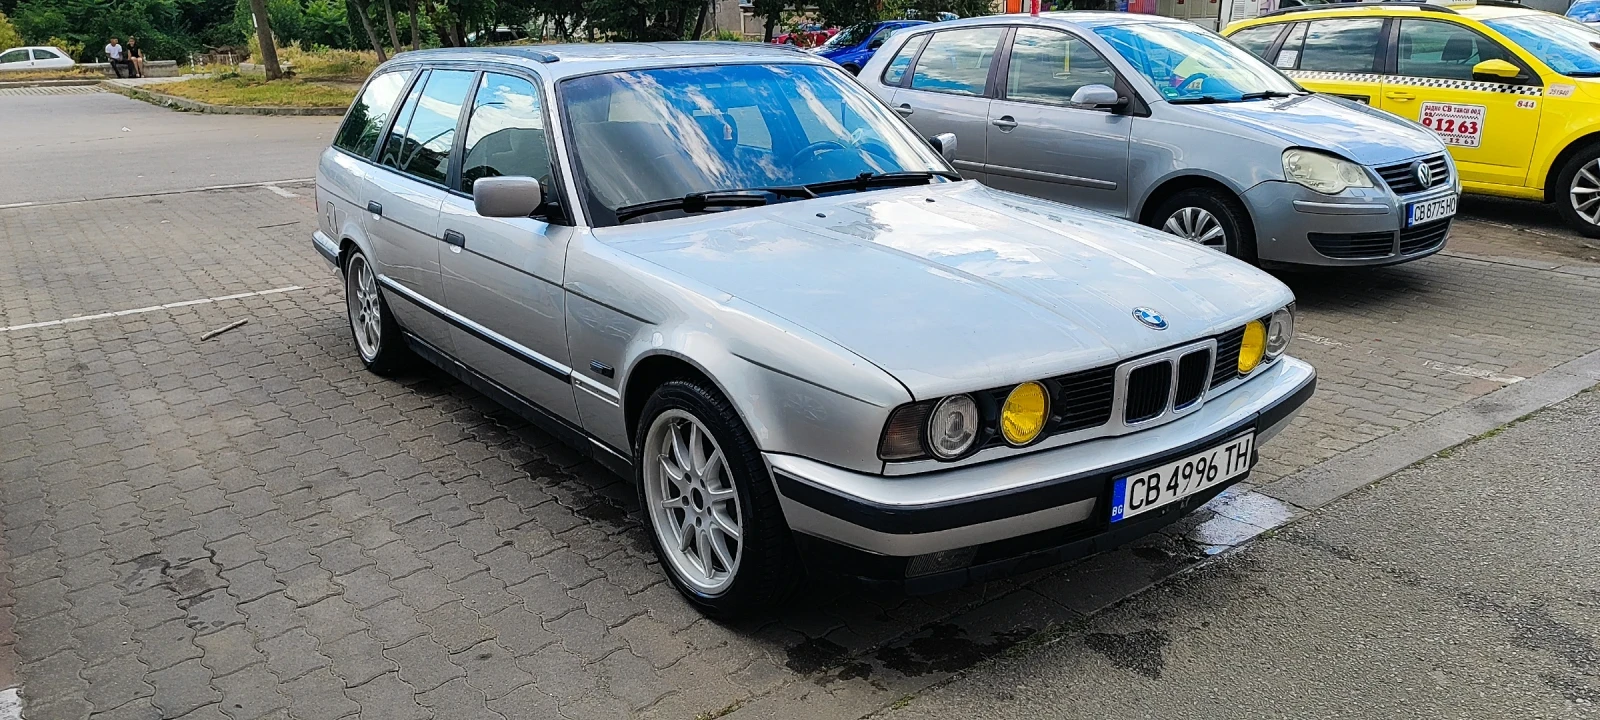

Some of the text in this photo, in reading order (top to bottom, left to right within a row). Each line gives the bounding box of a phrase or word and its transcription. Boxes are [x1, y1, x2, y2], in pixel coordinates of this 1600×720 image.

[1517, 100, 1535, 108] 844
[1435, 118, 1455, 133] 12
[1458, 120, 1478, 135] 63
[1414, 204, 1425, 222] CB
[1426, 199, 1445, 219] 8775
[1446, 197, 1456, 214] HO
[1129, 438, 1250, 511] CB 4996 TH
[1111, 503, 1123, 517] BG
